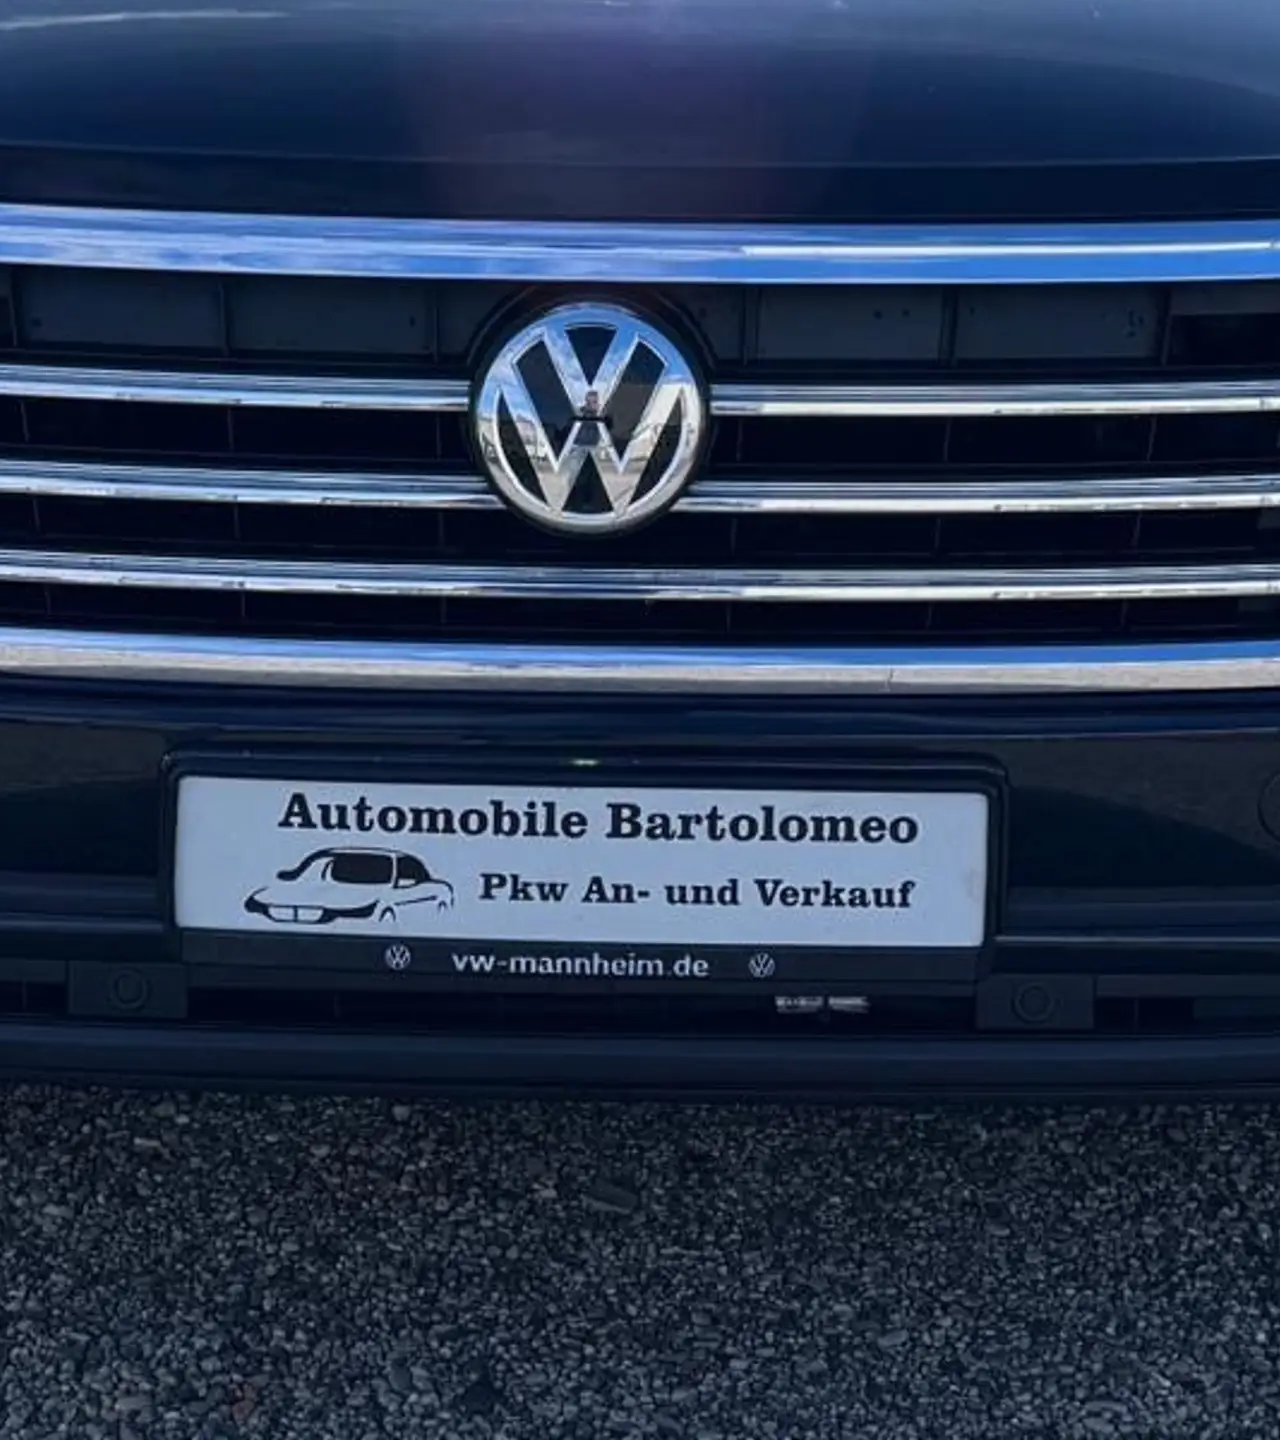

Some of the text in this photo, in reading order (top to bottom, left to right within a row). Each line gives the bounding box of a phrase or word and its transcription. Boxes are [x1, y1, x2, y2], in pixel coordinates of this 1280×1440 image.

[477, 303, 703, 534] VW
[277, 792, 918, 843] Automobile Bartolomeo
[479, 873, 916, 908] Pkw An- und Verkauf
[452, 951, 710, 977] vw-mannheim.de
